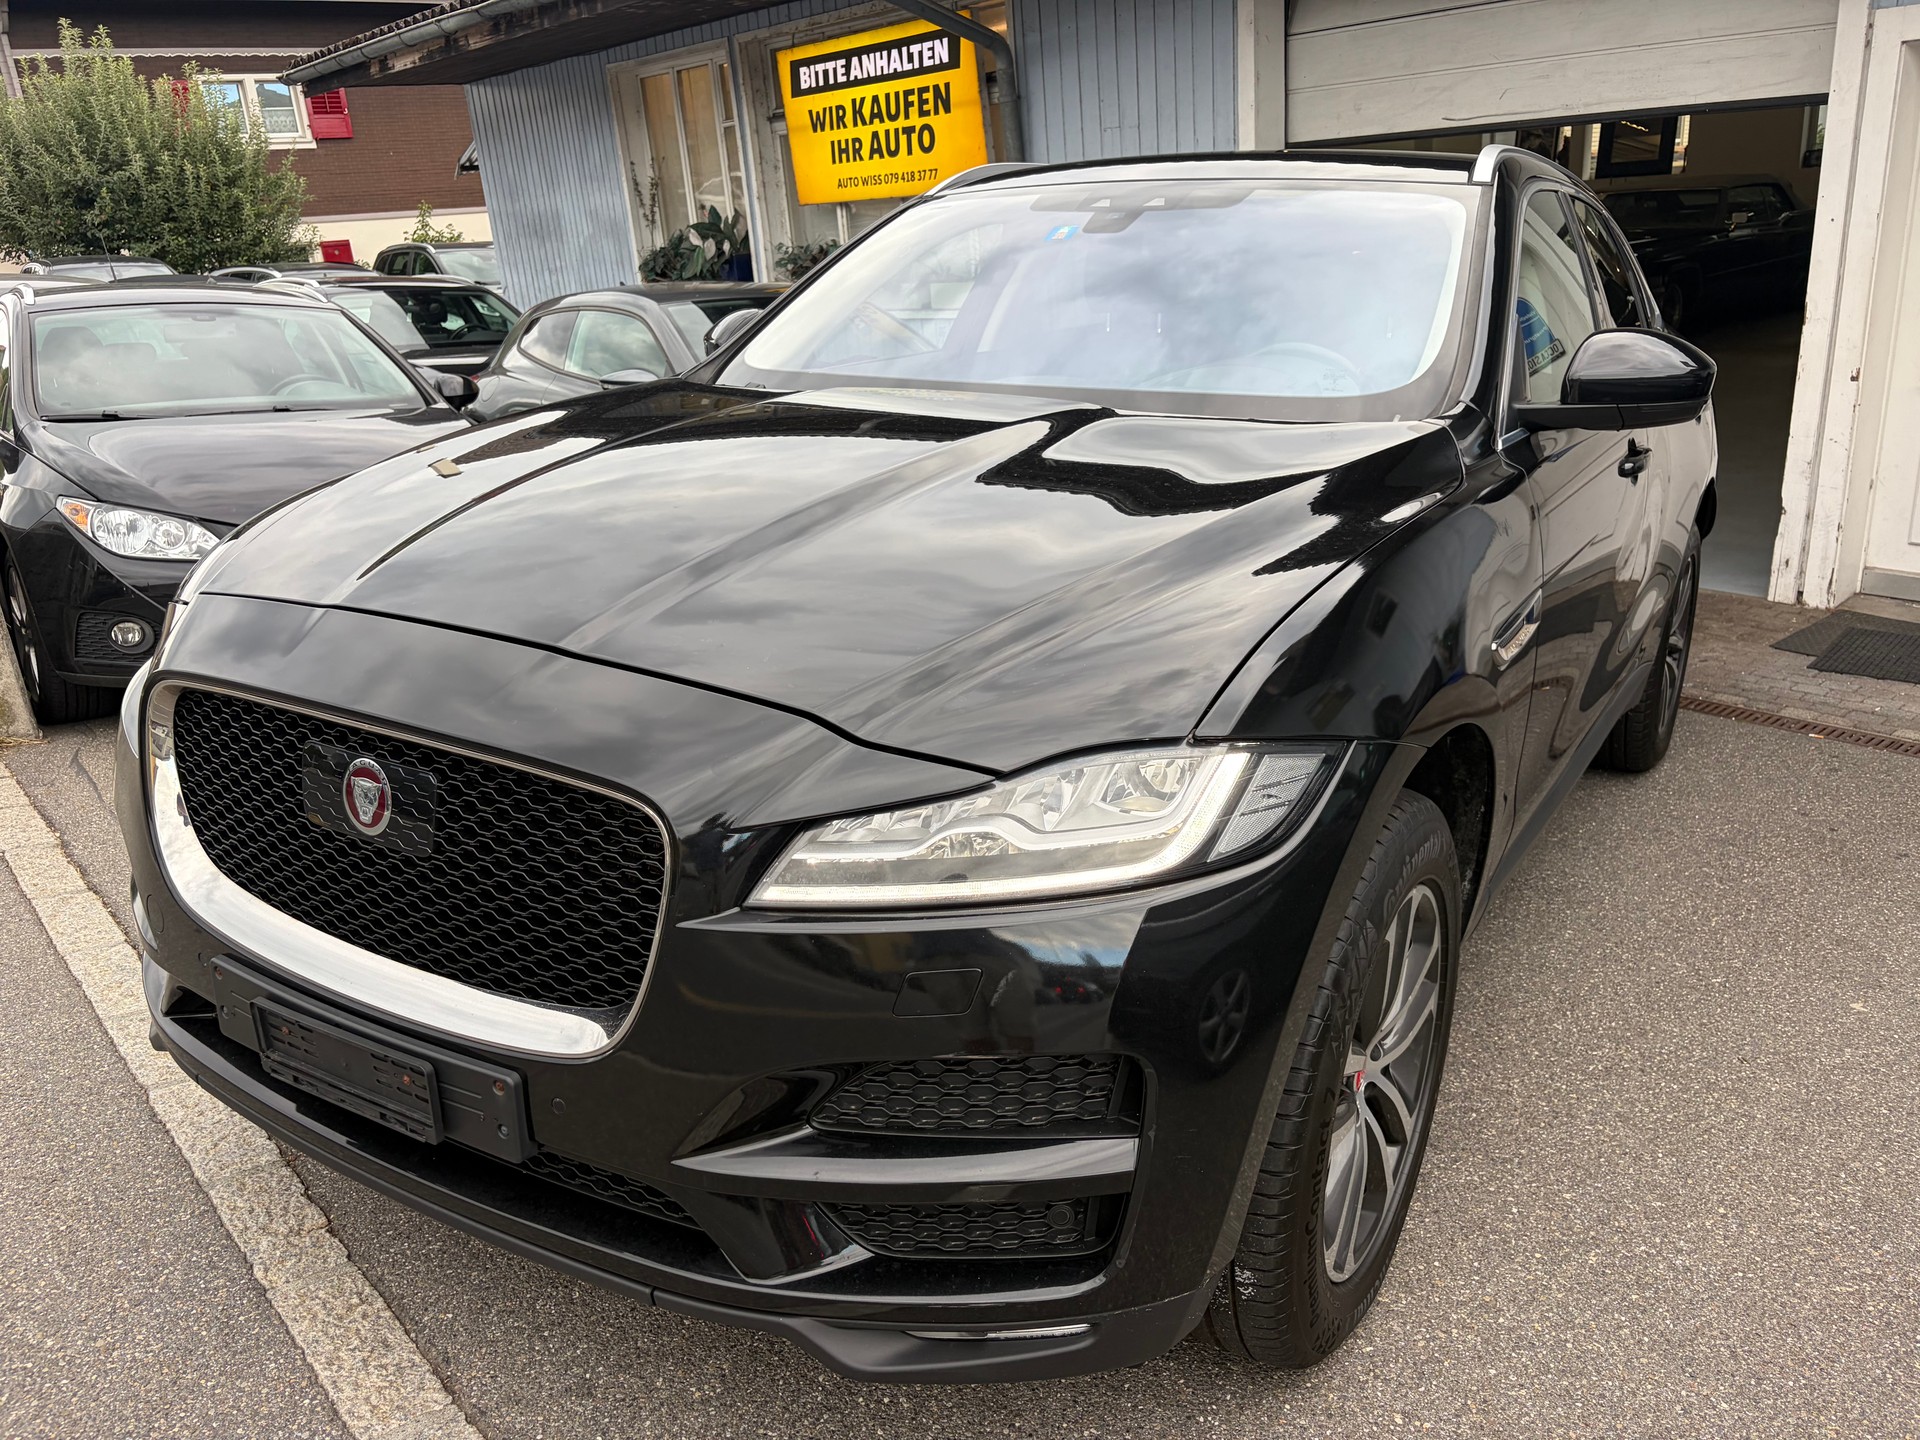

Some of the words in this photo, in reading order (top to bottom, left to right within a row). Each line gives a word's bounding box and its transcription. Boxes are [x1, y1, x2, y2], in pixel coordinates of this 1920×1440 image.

[799, 59, 847, 90] BITTE
[850, 37, 949, 80] ANHALTEN
[808, 104, 848, 134] WIR
[851, 82, 952, 128] KAUFEN
[830, 137, 864, 165] IHR
[868, 123, 936, 161] AUTO
[837, 176, 859, 189] AUTO
[861, 174, 883, 188] WISS
[884, 172, 900, 184] 079
[901, 171, 915, 183] 418
[917, 169, 928, 181] 37
[928, 168, 938, 181] 77
[347, 759, 391, 786] JAGUAR
[1303, 1118, 1331, 1328] PremiumContact
